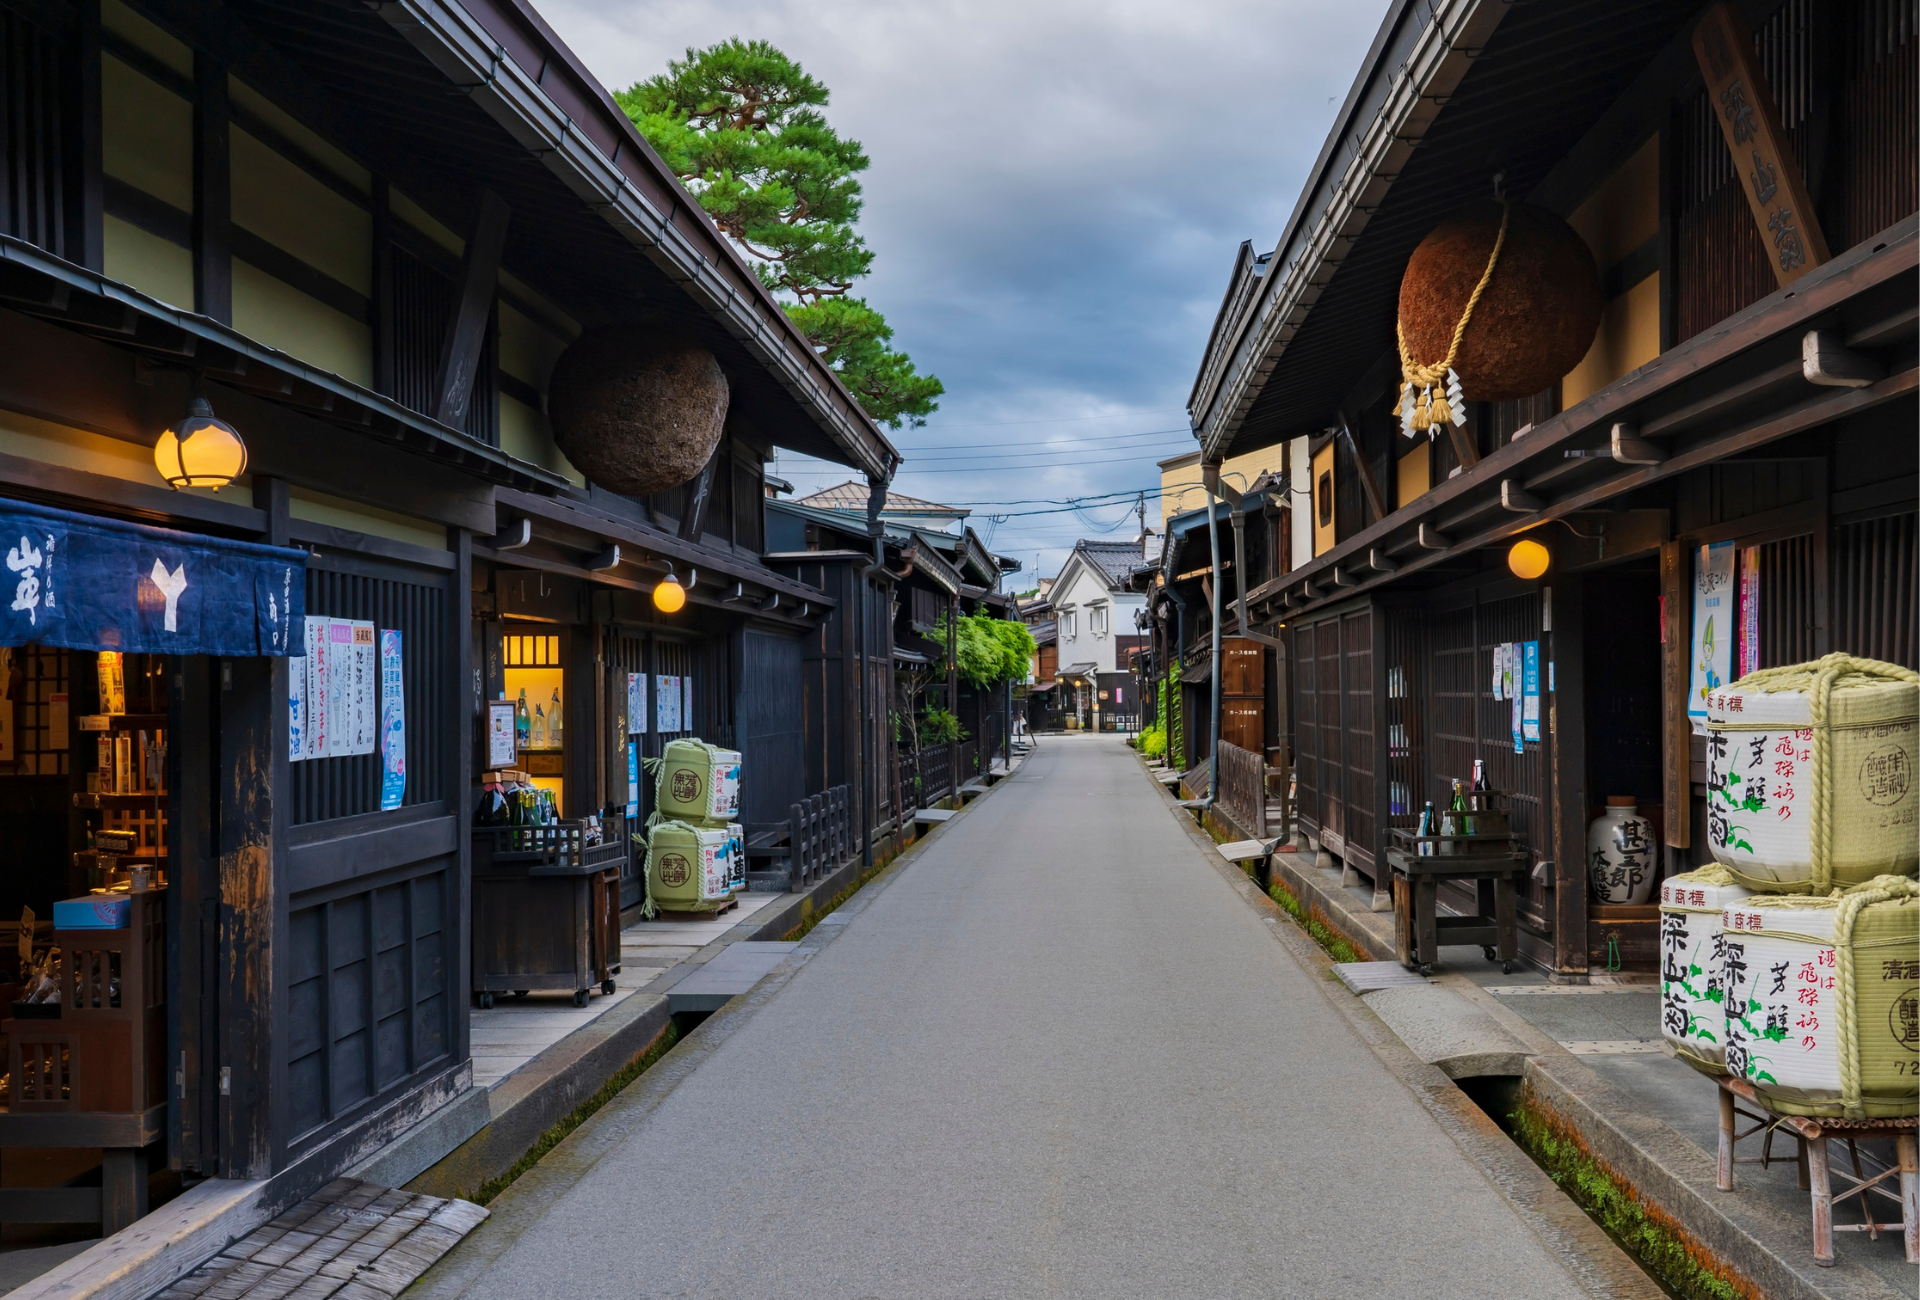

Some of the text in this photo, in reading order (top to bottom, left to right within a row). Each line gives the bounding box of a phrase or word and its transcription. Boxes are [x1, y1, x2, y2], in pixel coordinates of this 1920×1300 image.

[6, 535, 43, 626] 山車
[317, 625, 326, 752] 試飲できます
